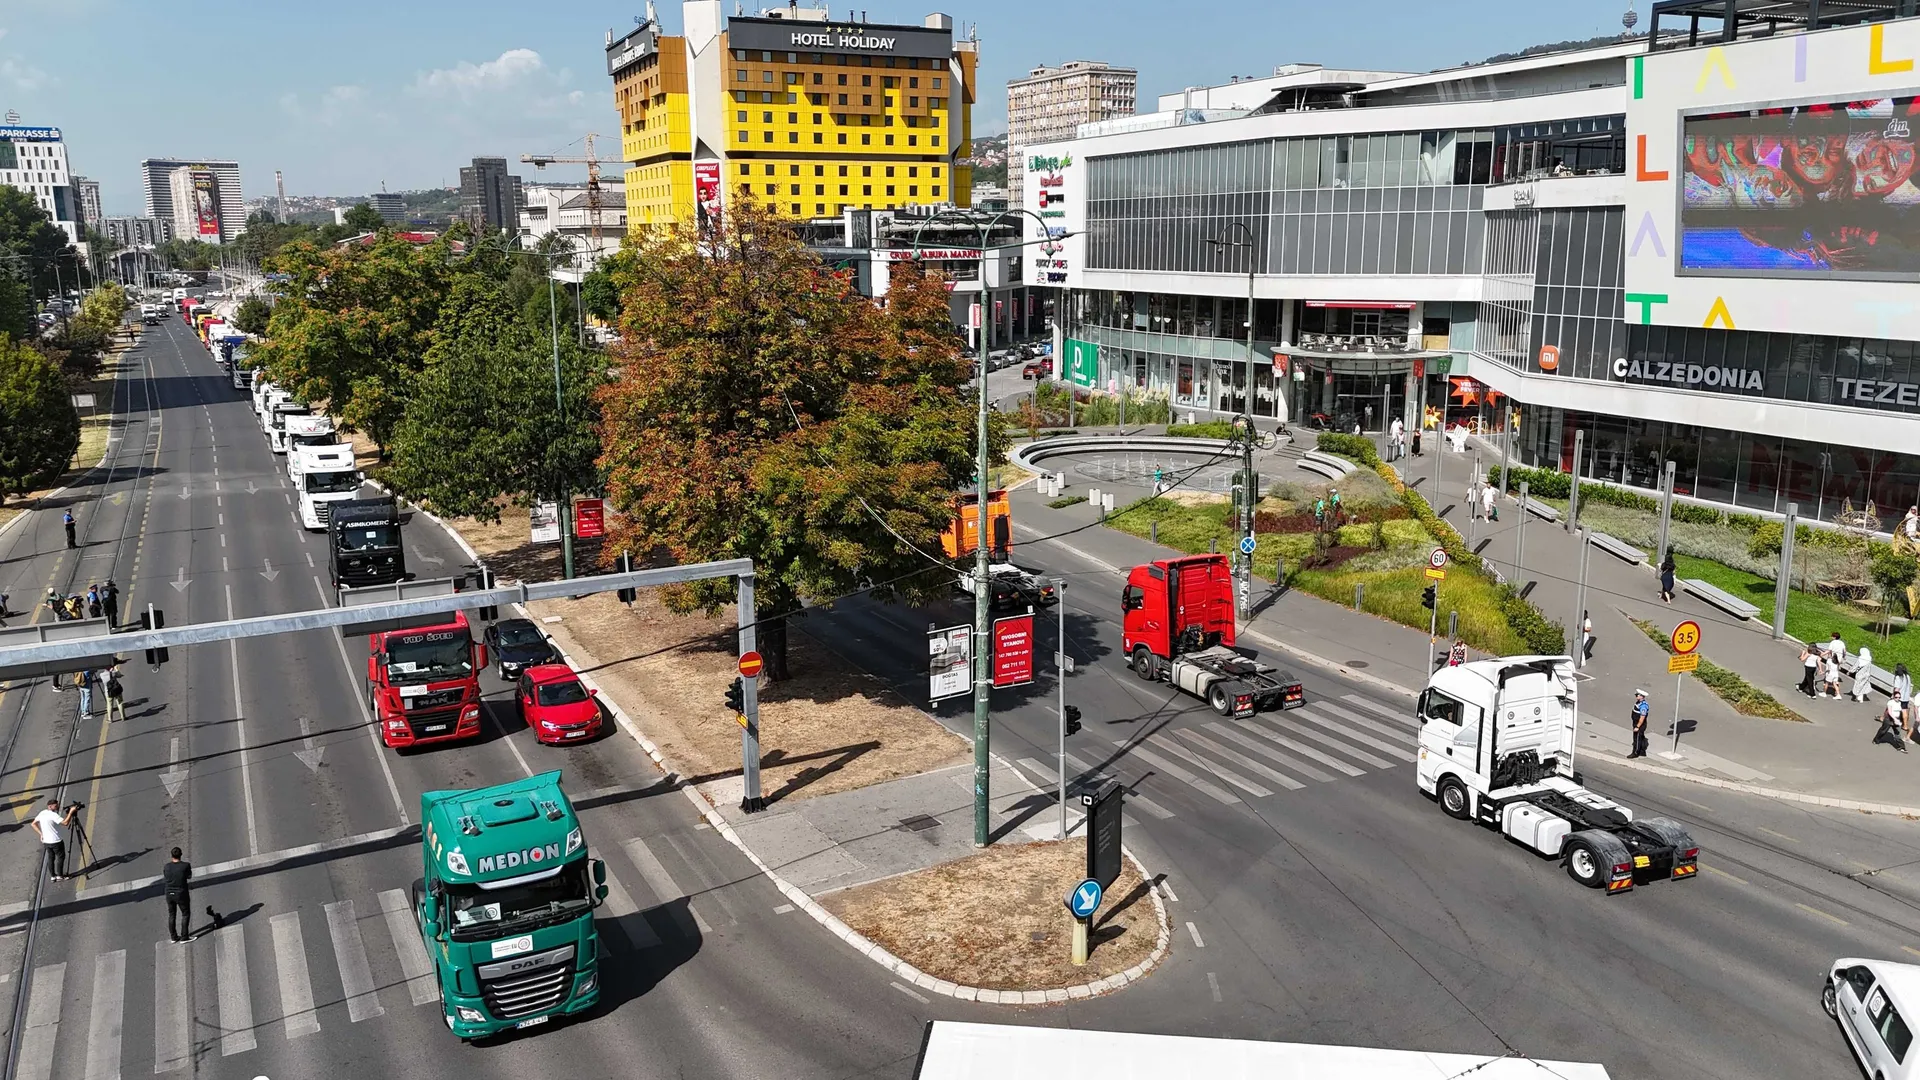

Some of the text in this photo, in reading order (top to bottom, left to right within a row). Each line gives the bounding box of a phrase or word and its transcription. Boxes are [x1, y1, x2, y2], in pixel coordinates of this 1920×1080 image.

[791, 33, 895, 50] HOTEL HOLIDAY
[1613, 357, 1764, 391] CALZEDONIA
[1836, 377, 1920, 406] TEZE
[1434, 553, 1444, 564] 60
[403, 635, 423, 643] TOP
[1001, 632, 1027, 640] DVOSOBNI
[1677, 632, 1693, 644] 3.5
[1003, 639, 1025, 648] STANOVI
[418, 697, 448, 706] MAN
[478, 843, 560, 874] MEDION
[511, 957, 545, 971] DAF
